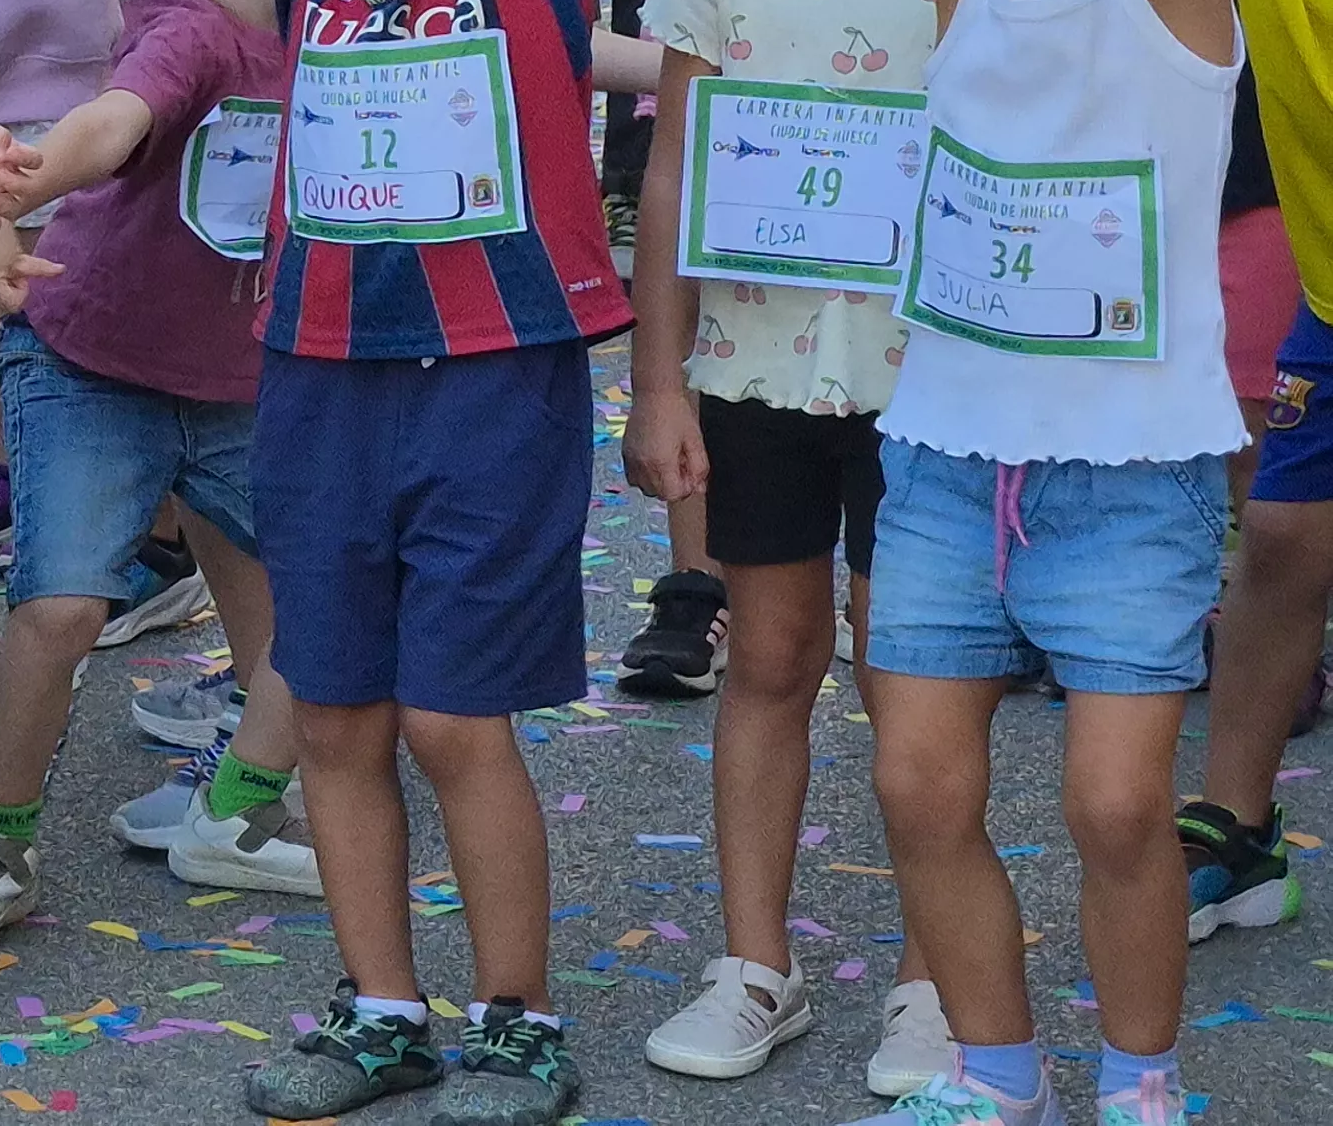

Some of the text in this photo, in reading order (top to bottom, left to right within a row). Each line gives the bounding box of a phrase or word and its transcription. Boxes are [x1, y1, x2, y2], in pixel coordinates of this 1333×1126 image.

[298, 61, 462, 86] ARRERA INFANTIL
[736, 97, 916, 129] CARRERA INFANTIL
[360, 128, 398, 171] 12
[832, 129, 879, 146] HUESCA
[796, 165, 844, 208] 49
[943, 155, 1108, 198] CARRERA INFANTIL
[1000, 203, 1016, 218] DE
[754, 217, 807, 247] ELSA
[988, 238, 1037, 285] 34
